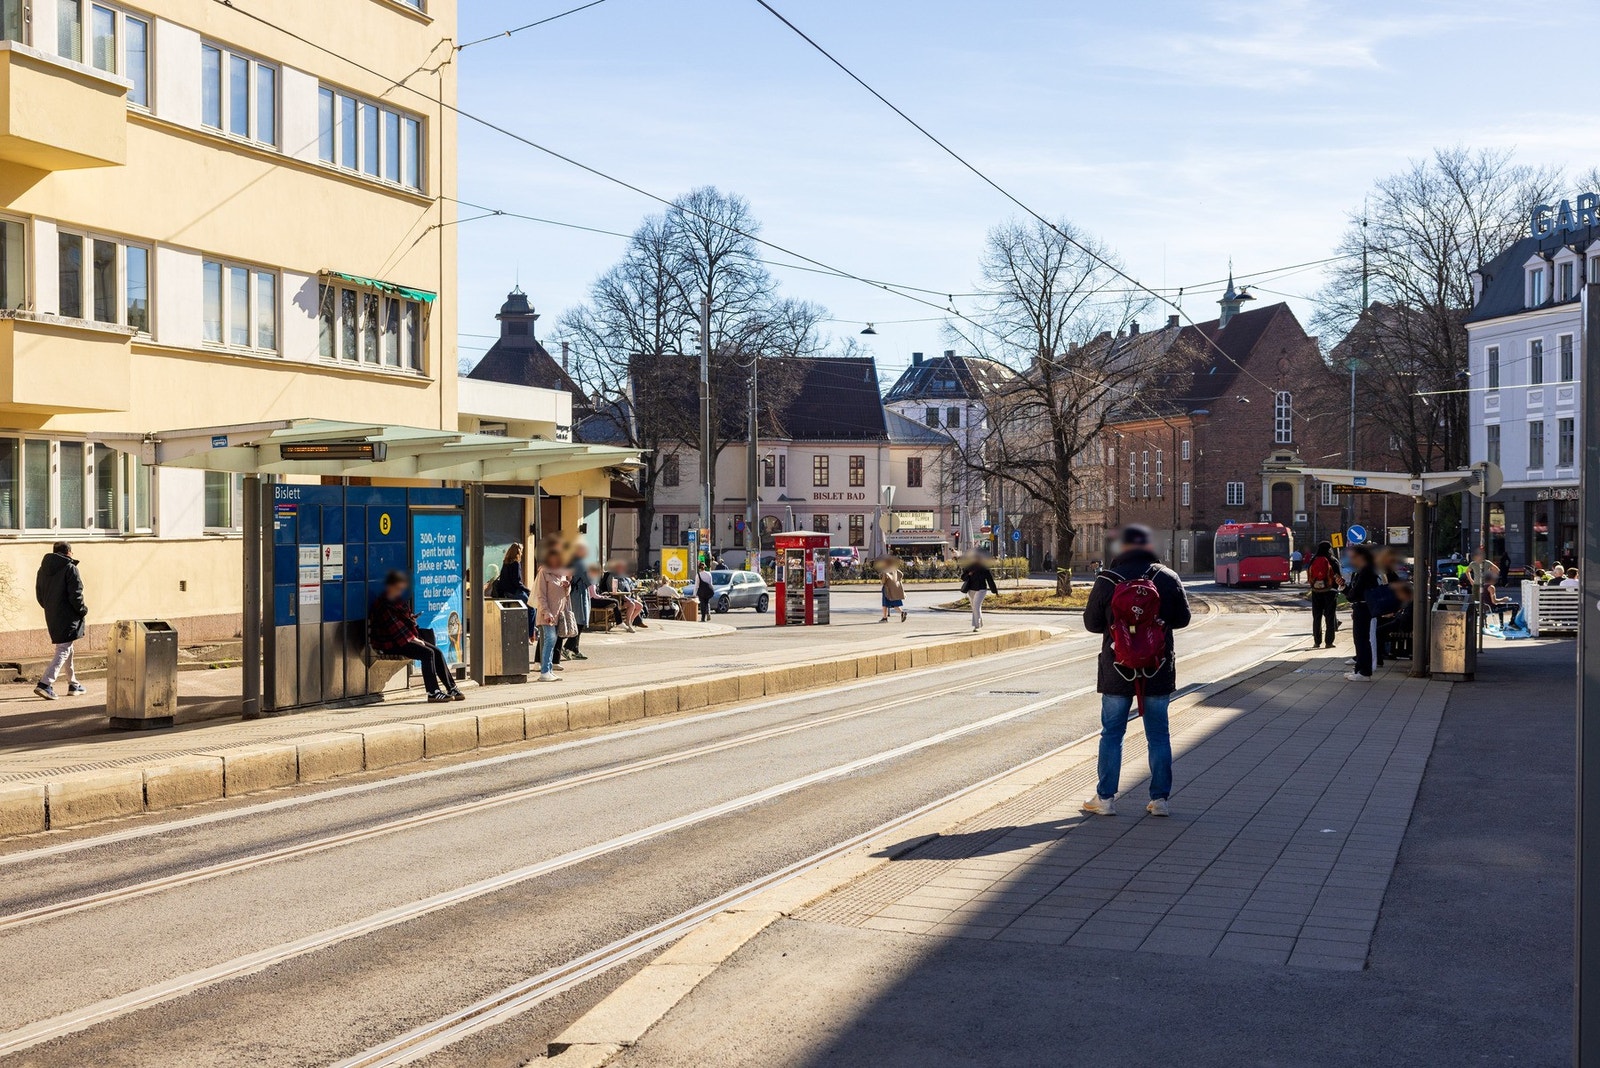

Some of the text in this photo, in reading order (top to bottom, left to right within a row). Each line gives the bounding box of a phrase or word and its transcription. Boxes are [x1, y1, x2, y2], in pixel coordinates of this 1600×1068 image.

[275, 486, 300, 500] Bislett
[383, 518, 388, 530] B
[420, 533, 456, 544] 300,- for en
[1334, 536, 1340, 546] 1
[422, 547, 455, 559] pent brukt
[417, 560, 459, 574] jakke er 300,-
[420, 574, 457, 584] mer enn om
[424, 586, 454, 598] du lar den
[428, 600, 450, 614] henge.
